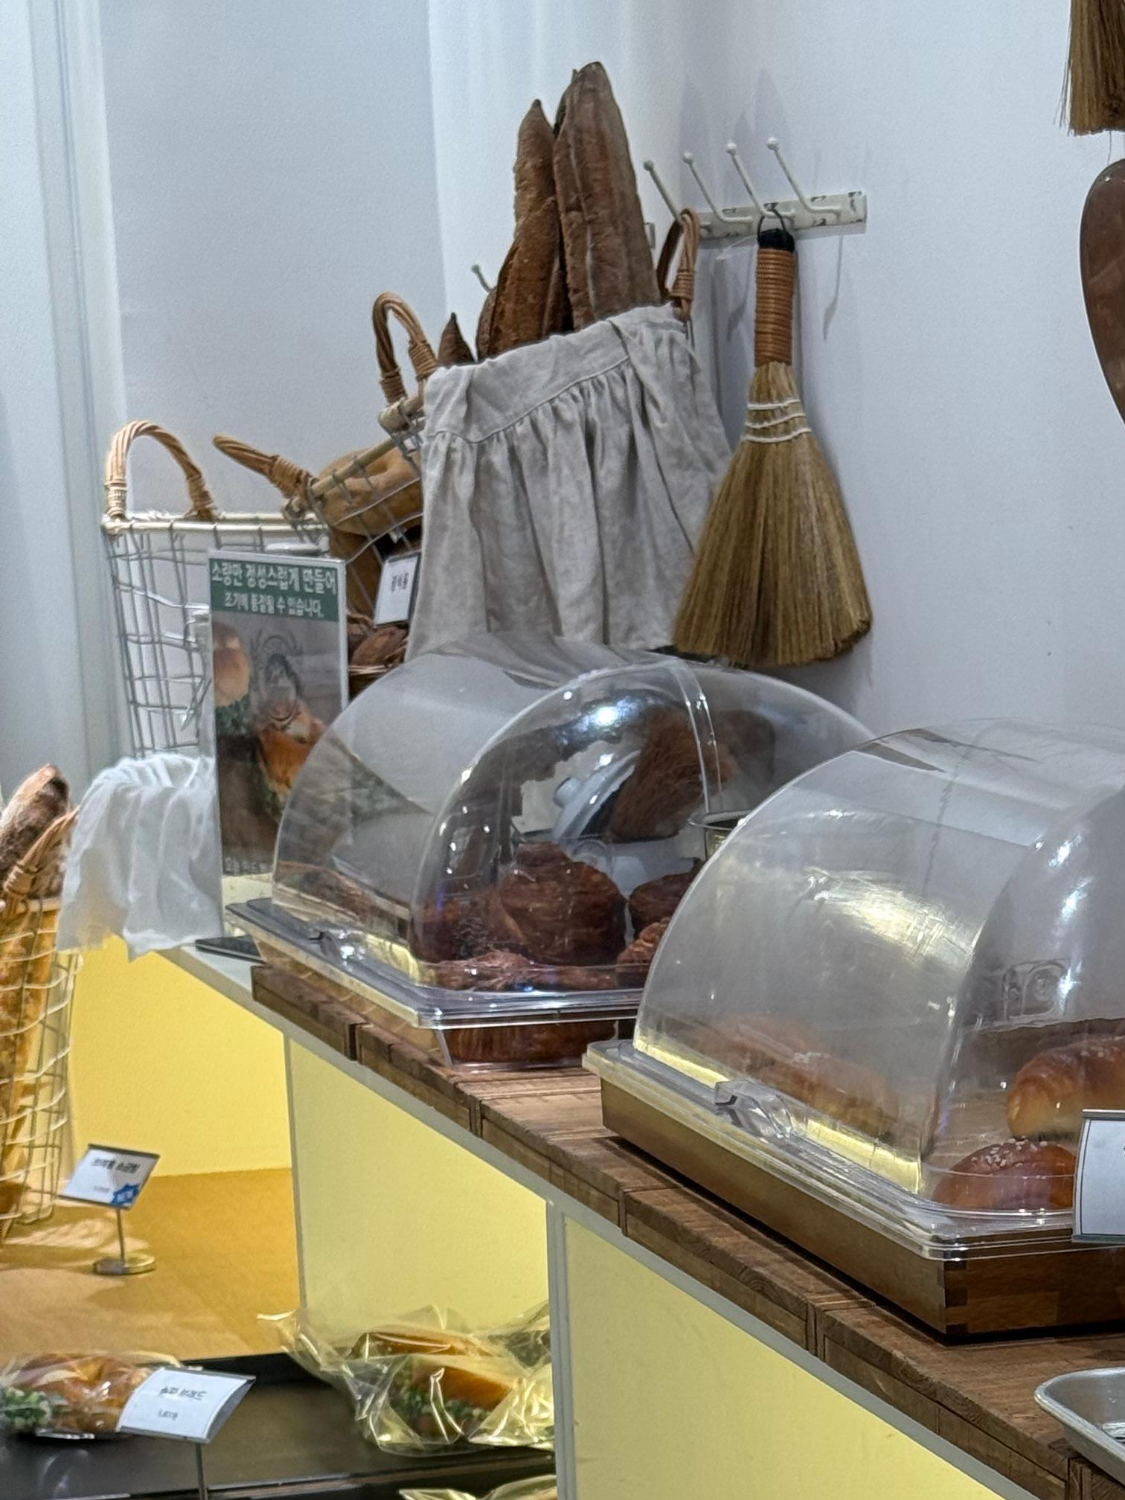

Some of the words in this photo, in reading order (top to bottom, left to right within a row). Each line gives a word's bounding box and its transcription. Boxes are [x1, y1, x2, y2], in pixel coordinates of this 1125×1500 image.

[211, 561, 243, 587] 소량만
[245, 563, 300, 592] 정성스럽게
[302, 568, 337, 595] 만들어
[277, 595, 286, 614] 수
